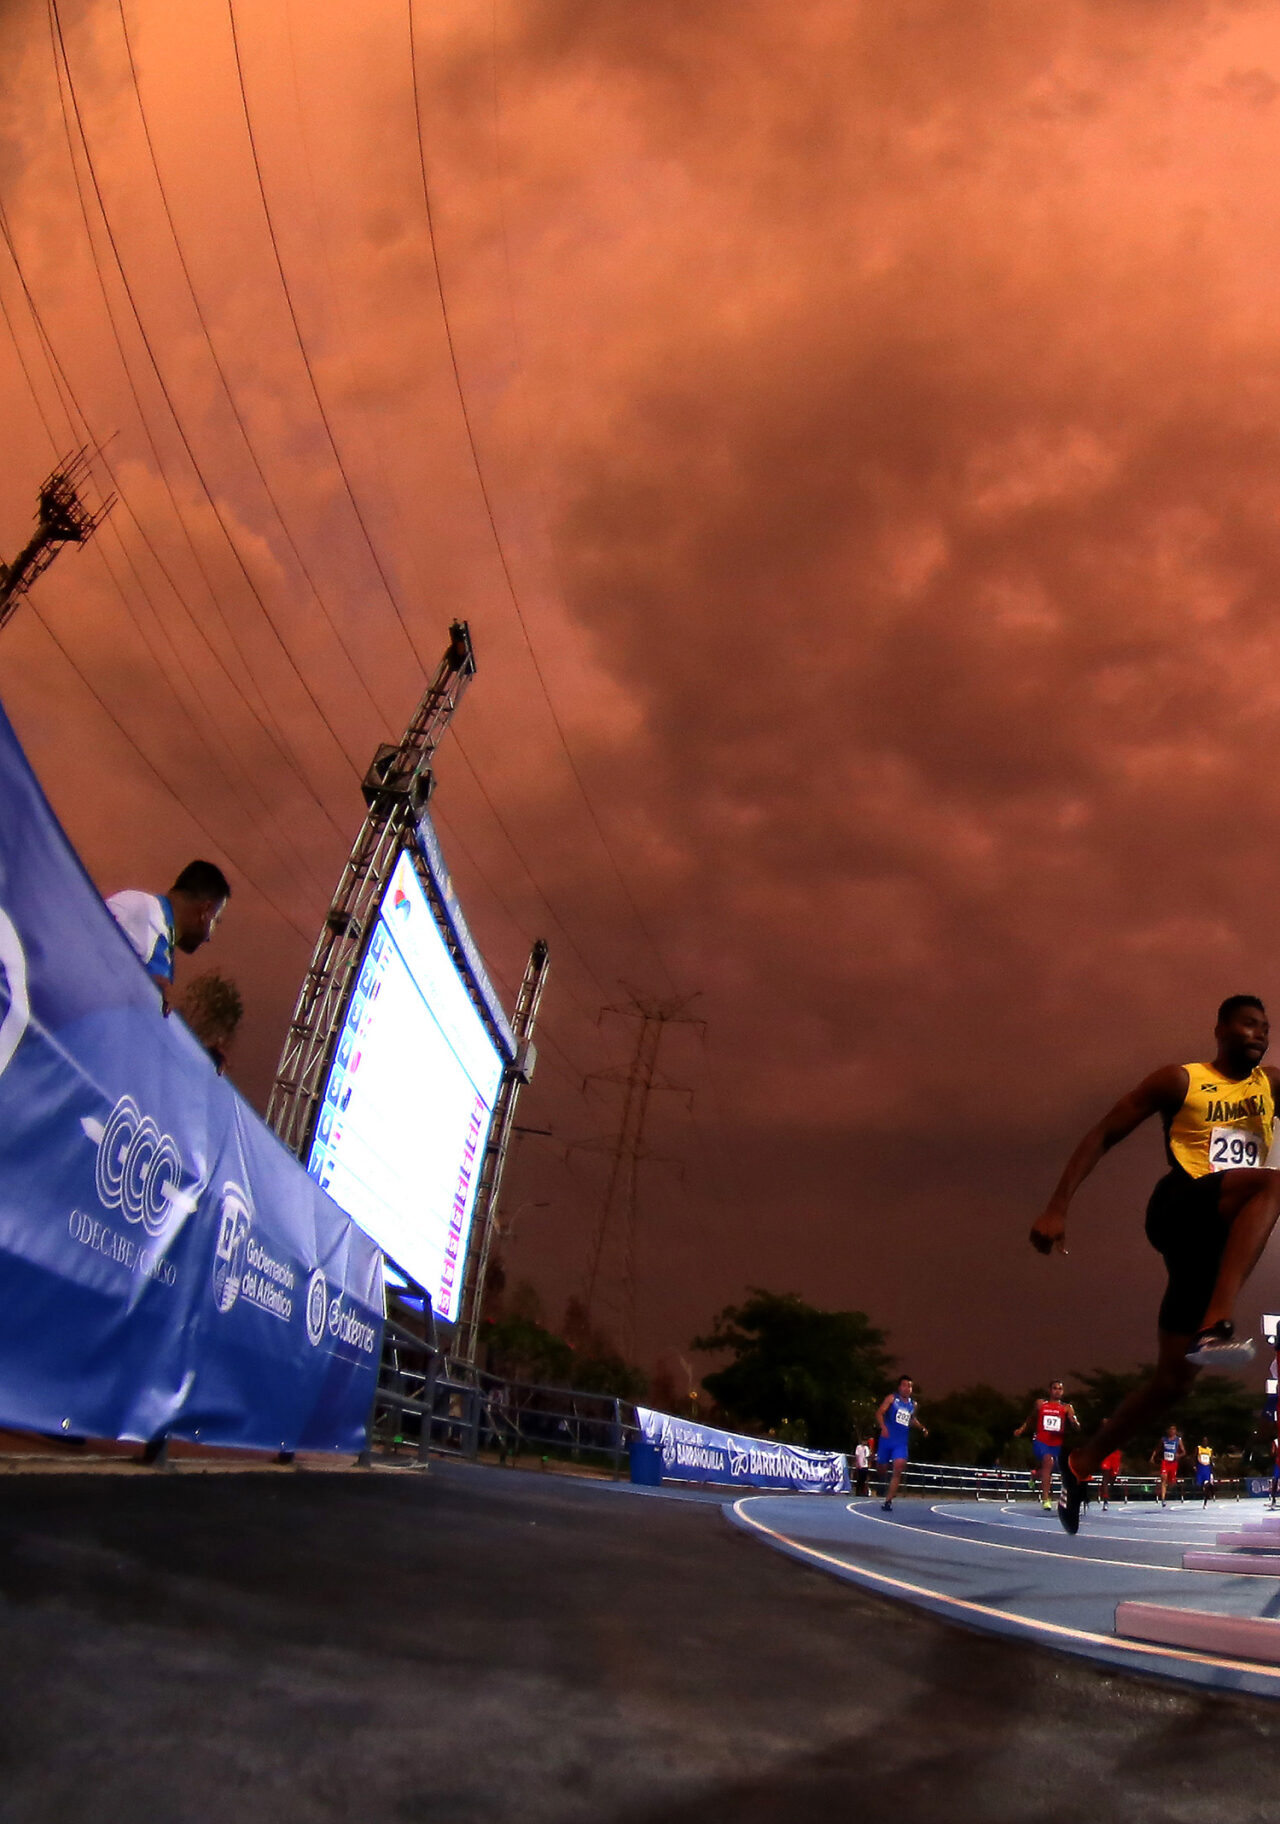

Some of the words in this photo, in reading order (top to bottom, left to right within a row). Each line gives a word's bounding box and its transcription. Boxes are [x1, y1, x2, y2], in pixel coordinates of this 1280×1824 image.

[1212, 1137, 1258, 1166] 299
[242, 1270, 258, 1298] del
[1046, 1418, 1058, 1426] 97
